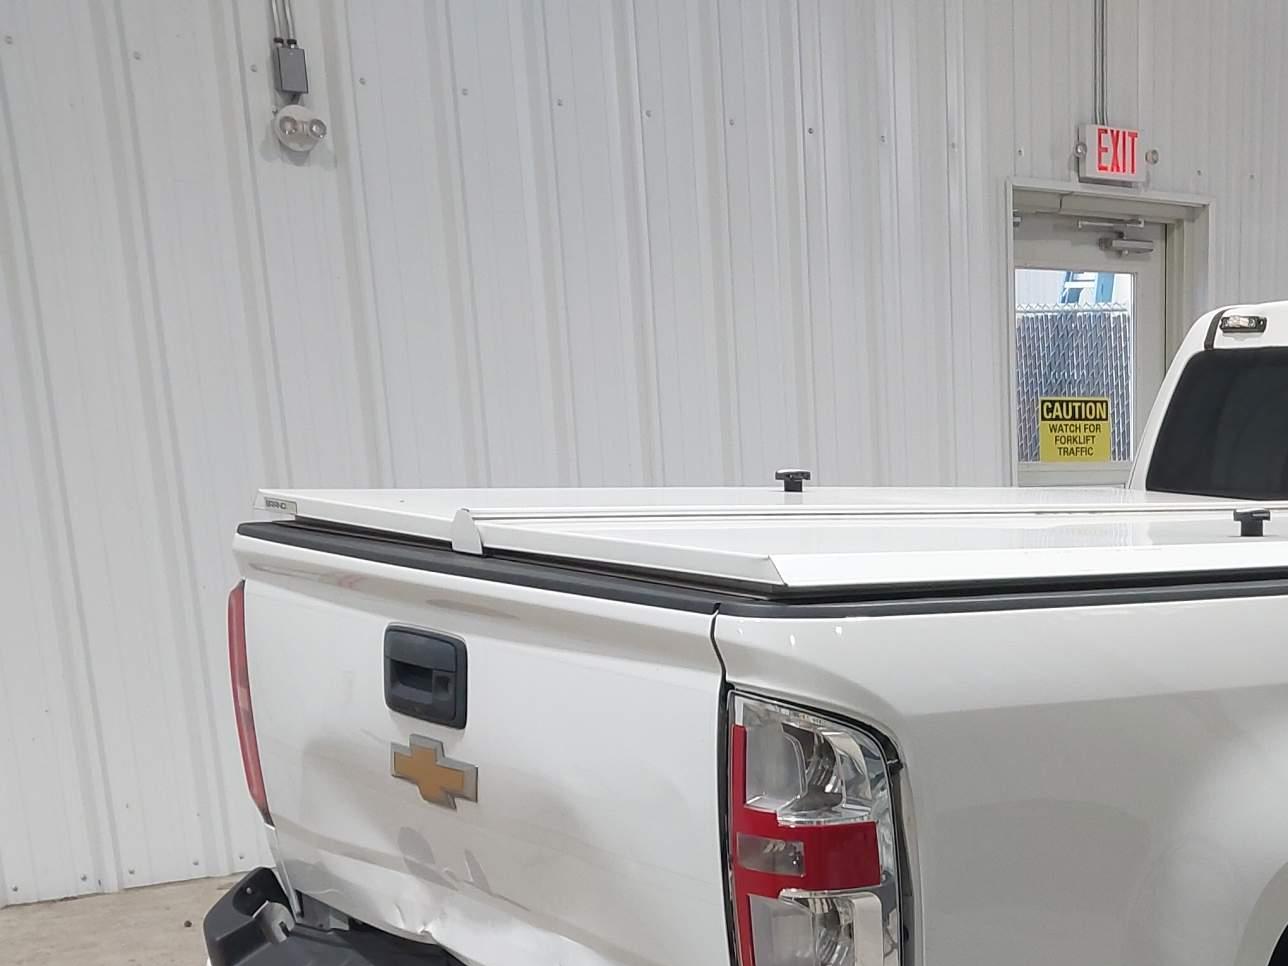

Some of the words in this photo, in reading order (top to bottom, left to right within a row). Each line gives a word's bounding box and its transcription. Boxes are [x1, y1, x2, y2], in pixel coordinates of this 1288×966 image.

[1097, 127, 1138, 175] EXIT
[1043, 402, 1106, 419] CAUTION
[1048, 423, 1081, 433] WATCH
[1083, 423, 1101, 433] FOR
[1054, 435, 1096, 445] FORKLIFT
[1057, 446, 1094, 456] TRAFFIC
